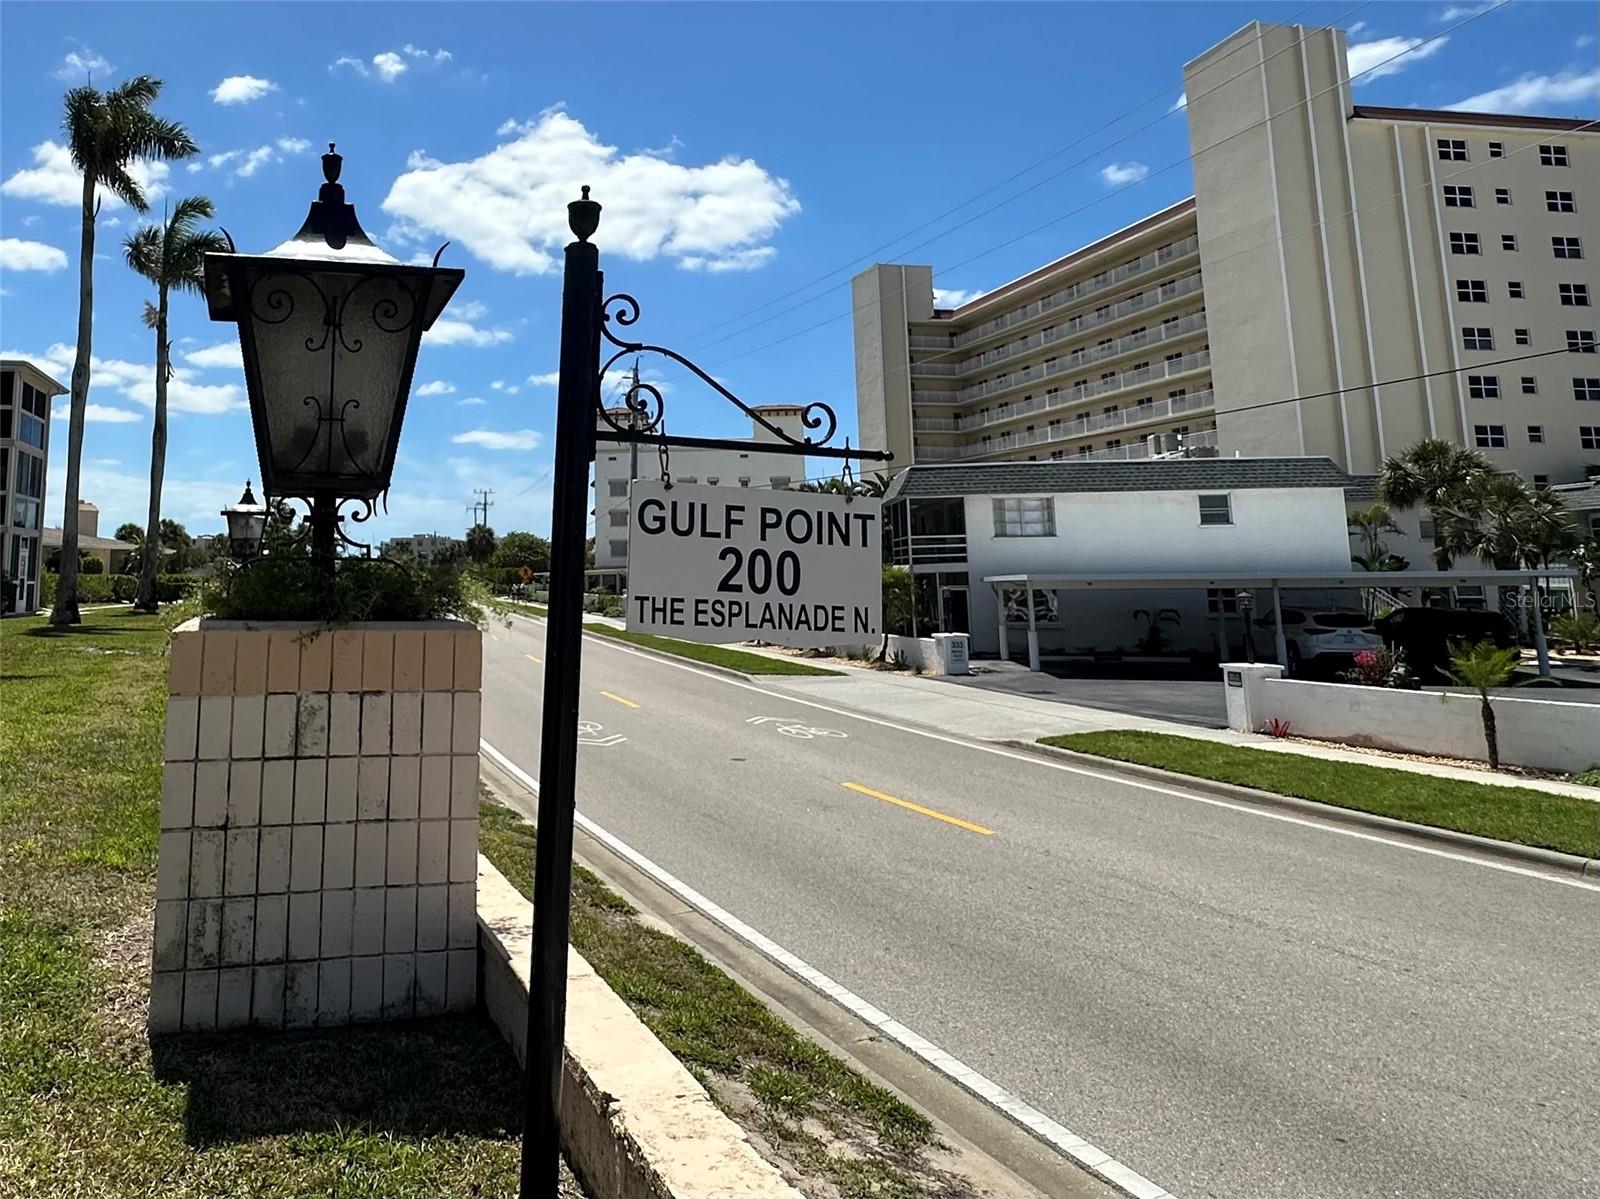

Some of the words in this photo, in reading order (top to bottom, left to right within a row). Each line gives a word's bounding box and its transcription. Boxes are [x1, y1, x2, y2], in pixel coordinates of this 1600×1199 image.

[637, 498, 746, 539] GULF
[760, 506, 876, 548] POINT
[716, 546, 801, 596] 200
[634, 595, 685, 625] THE
[694, 598, 846, 633] ESPLANADE
[853, 606, 876, 634] N.
